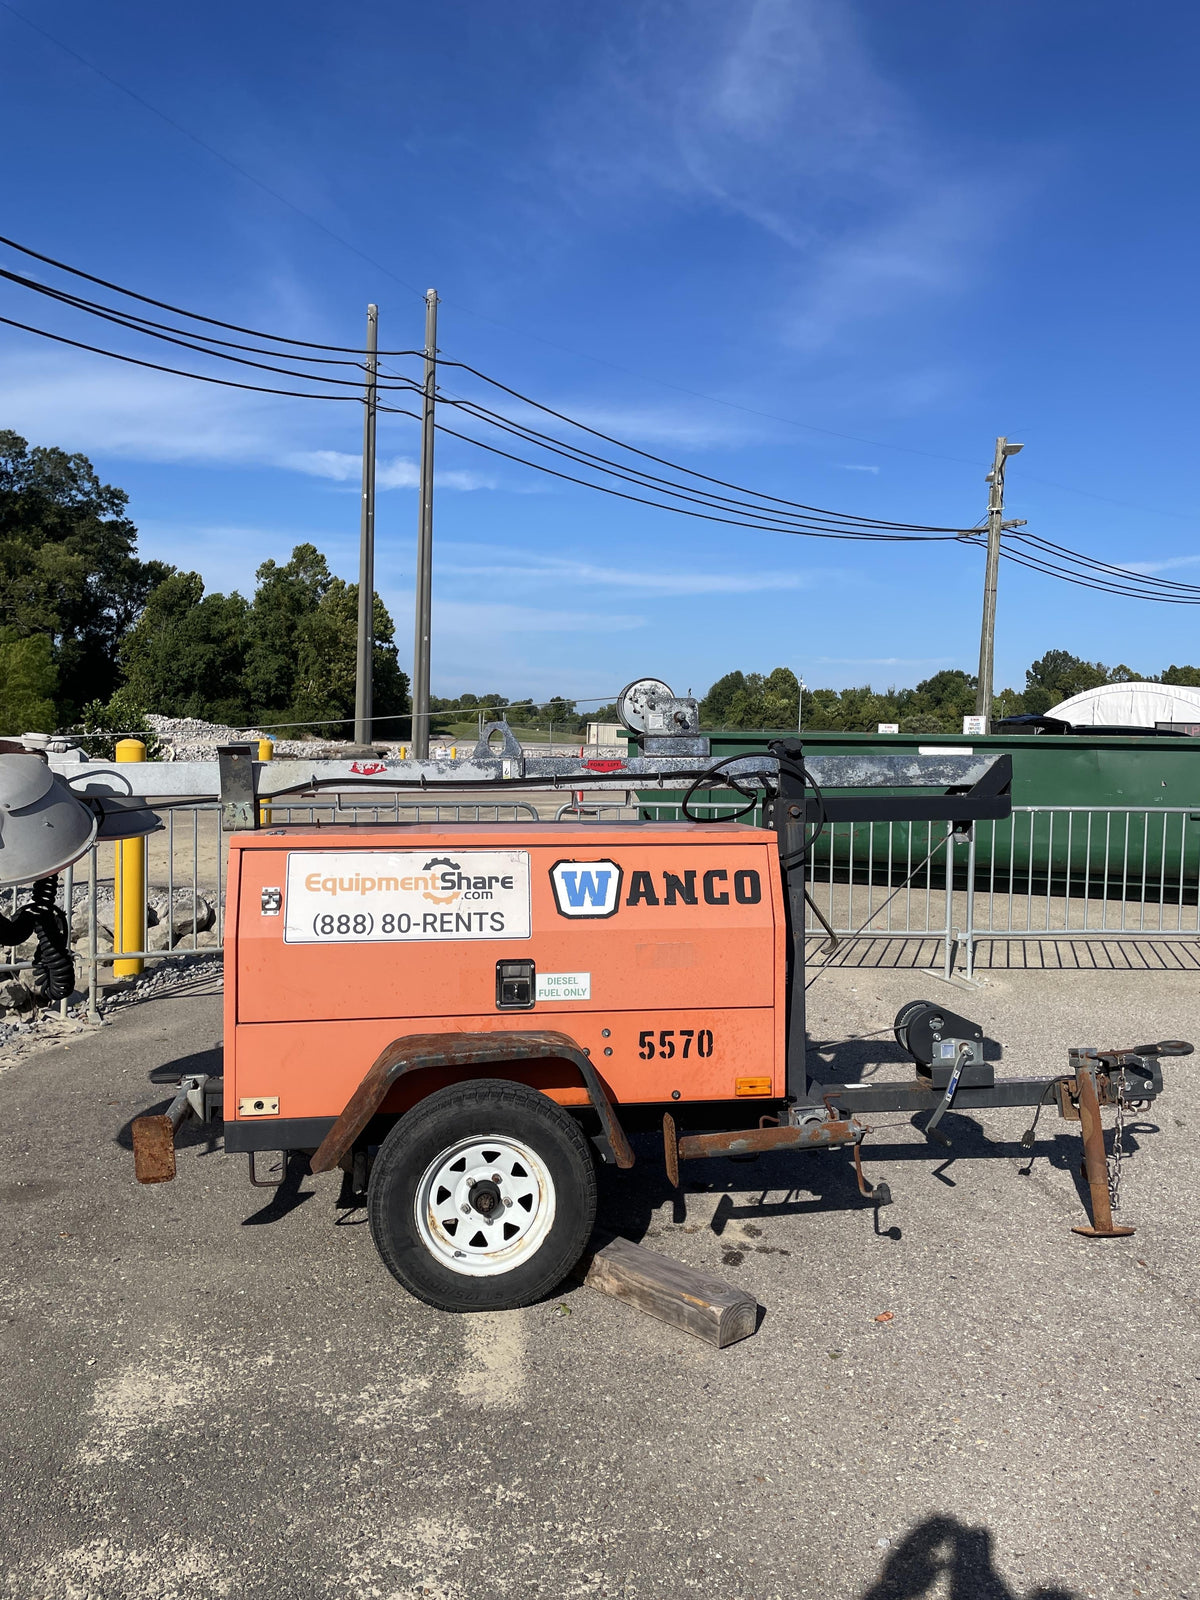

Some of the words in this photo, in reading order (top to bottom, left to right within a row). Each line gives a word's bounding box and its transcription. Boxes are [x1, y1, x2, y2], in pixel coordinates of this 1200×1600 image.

[305, 872, 513, 895] EquipmentShare
[561, 869, 761, 906] WANCO
[312, 912, 374, 936] (888)
[381, 911, 505, 934] 80-RENTS
[538, 988, 562, 998] FUEL
[564, 987, 587, 997] ONLY
[547, 976, 579, 986] DIESEL
[638, 1029, 714, 1060] 5570
